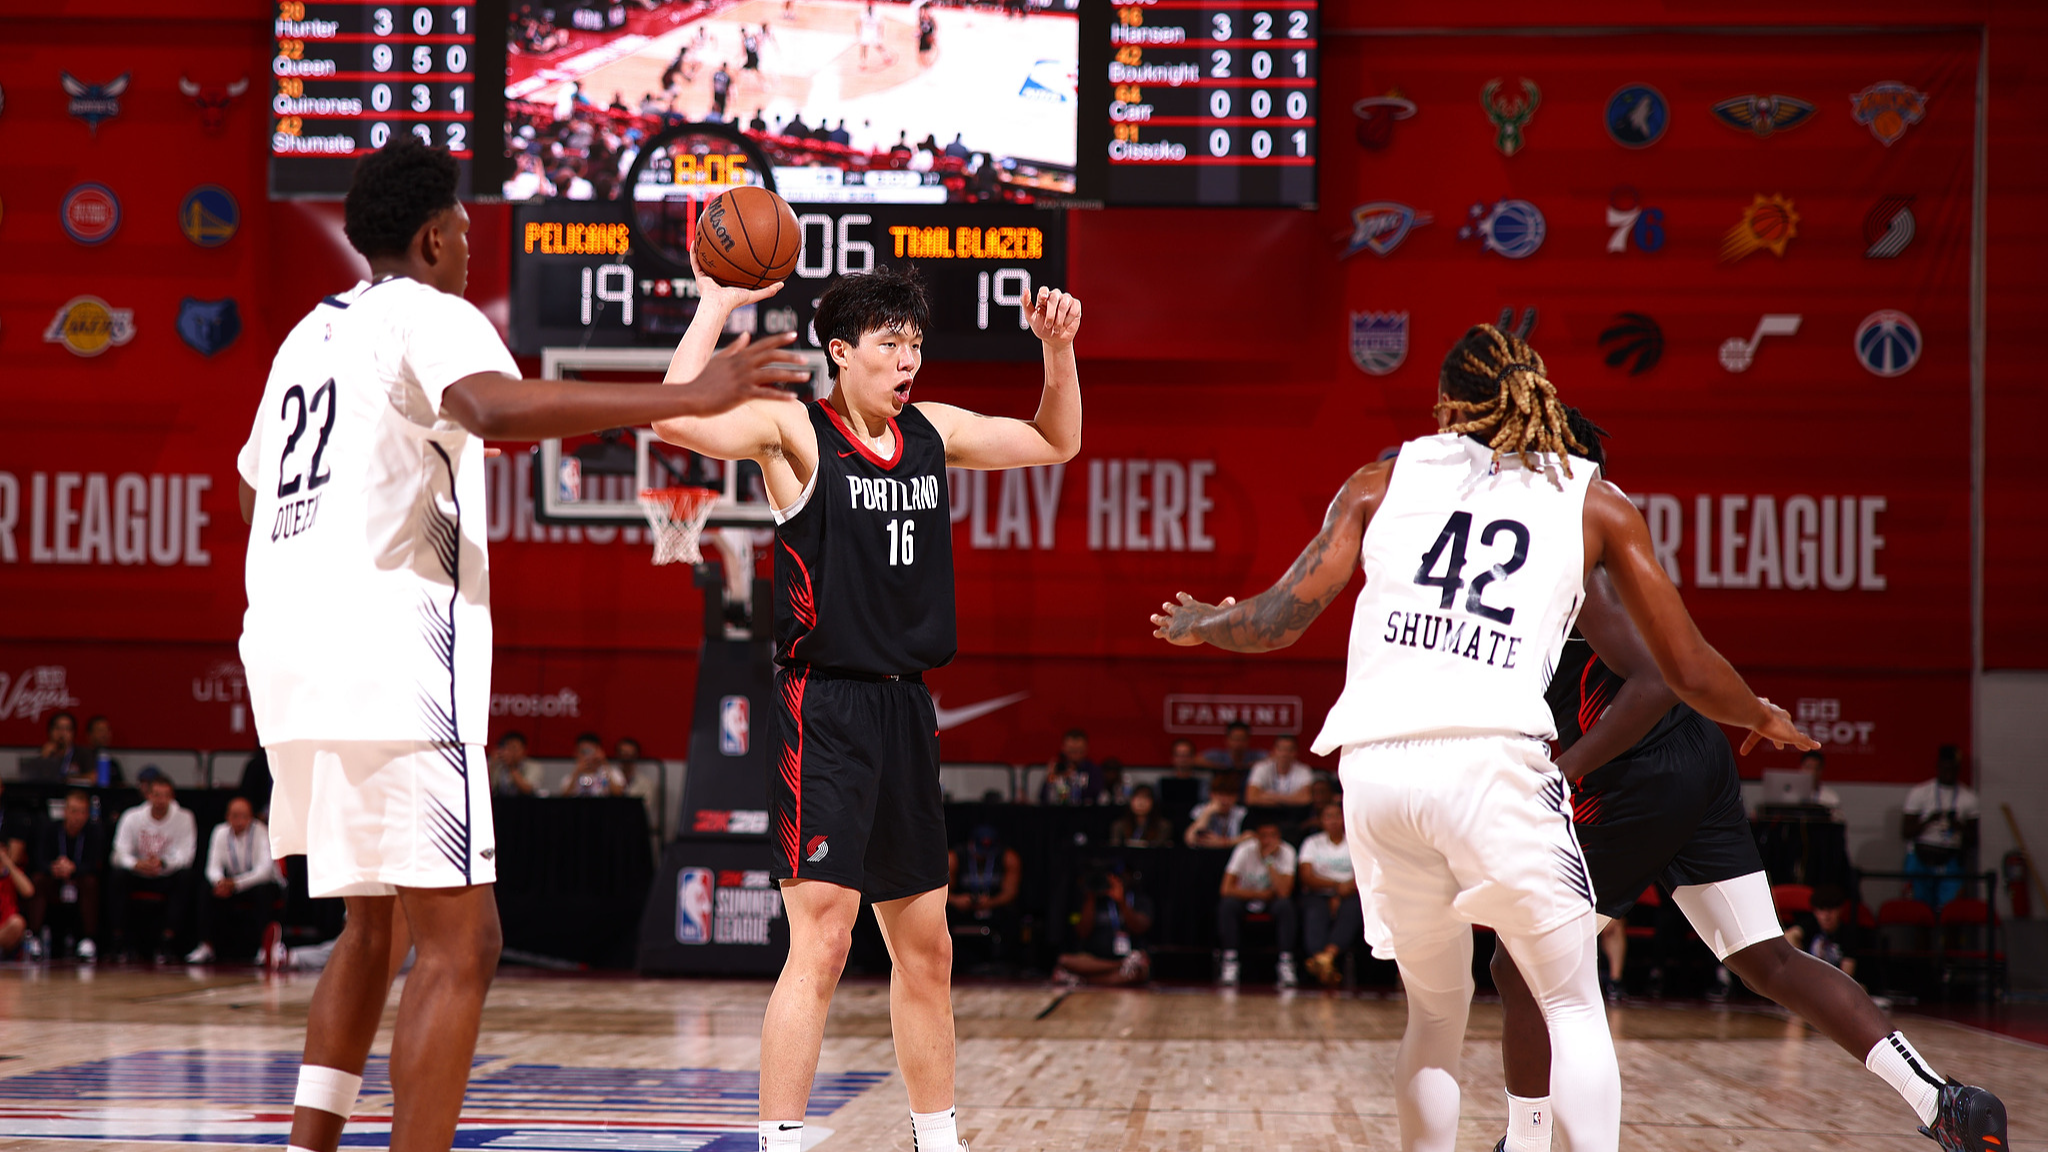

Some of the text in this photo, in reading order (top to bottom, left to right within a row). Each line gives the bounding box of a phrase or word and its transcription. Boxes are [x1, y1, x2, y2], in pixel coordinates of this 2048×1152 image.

[275, 6, 467, 38] Hunter 3 0 1
[1111, 10, 1308, 44] Hansen 3 2 2
[272, 43, 467, 77] Queen 9 5 0
[1108, 49, 1307, 87] Bouknight 2 0 1
[371, 83, 392, 112] 0
[411, 83, 431, 113] 3
[449, 86, 465, 114] 1
[1109, 89, 1307, 122] Carr 0 0 0
[272, 131, 356, 153] Shumate
[370, 121, 391, 149] 0
[446, 122, 466, 151] 2
[1108, 128, 1307, 161] Cissoko 0 0 1
[674, 154, 748, 185] 8:06
[525, 222, 629, 255] PELICANS
[889, 226, 1043, 259] TRAIL BLAZER
[1606, 206, 1666, 253] 76
[581, 263, 634, 325] 19
[977, 268, 1031, 330] 19
[277, 377, 336, 499] 22
[846, 475, 939, 512] PORTLAND
[947, 459, 1215, 552] PLAY HERE
[30, 472, 212, 566] LEAGUE
[886, 519, 915, 566] 16
[1694, 494, 1887, 591] LEAGUE
[1413, 511, 1530, 626] 42
[1384, 611, 1522, 669] SHUMATE
[1177, 703, 1291, 726] PANINI
[715, 887, 782, 918] SUMMER
[714, 916, 771, 945] LEAGUE
